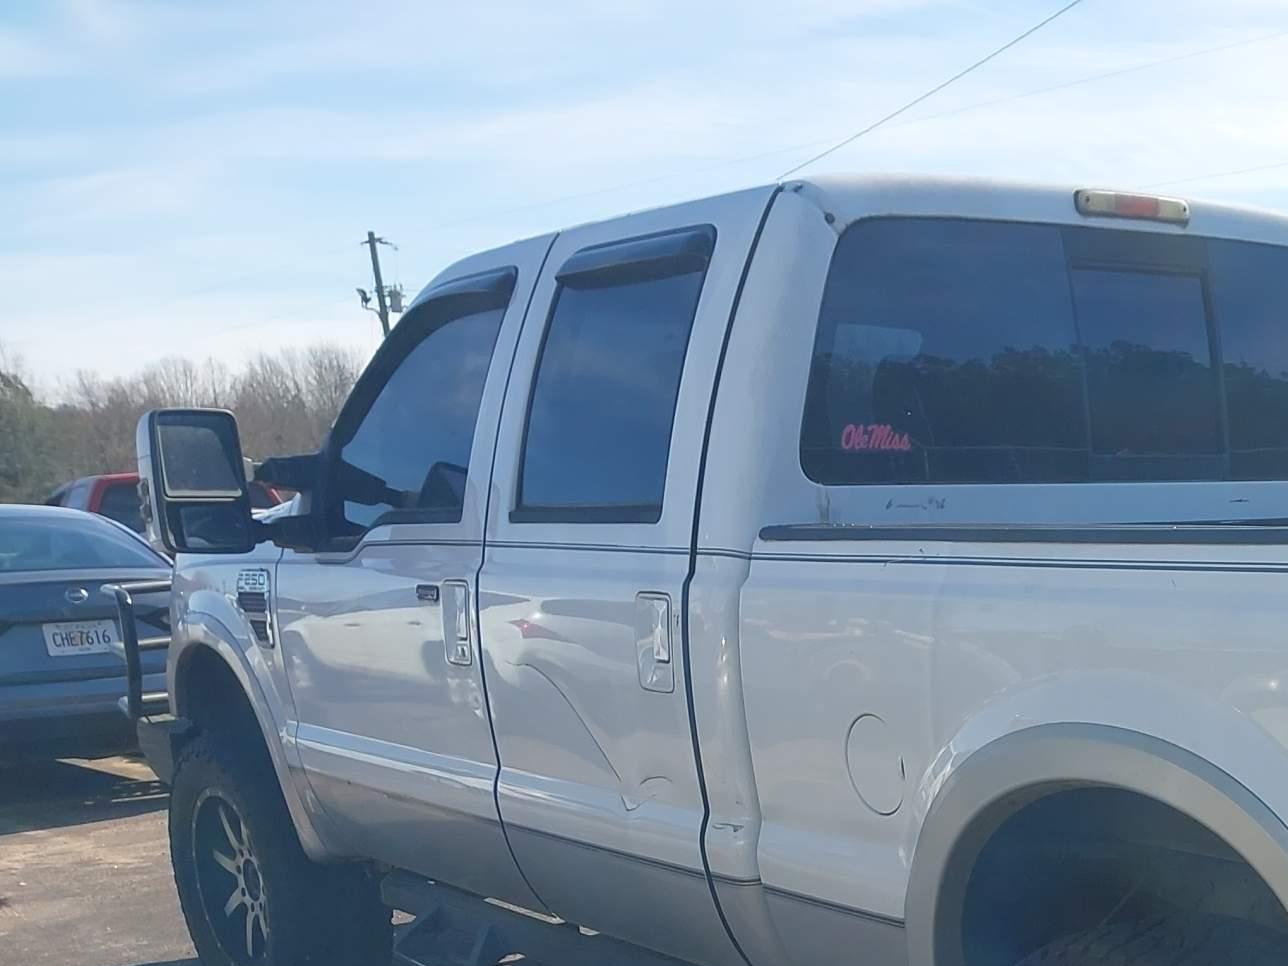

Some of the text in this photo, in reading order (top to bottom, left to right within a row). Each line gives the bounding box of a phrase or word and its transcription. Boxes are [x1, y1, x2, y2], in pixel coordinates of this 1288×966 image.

[841, 423, 912, 450] Ole Miss
[52, 629, 112, 648] CHE7616
